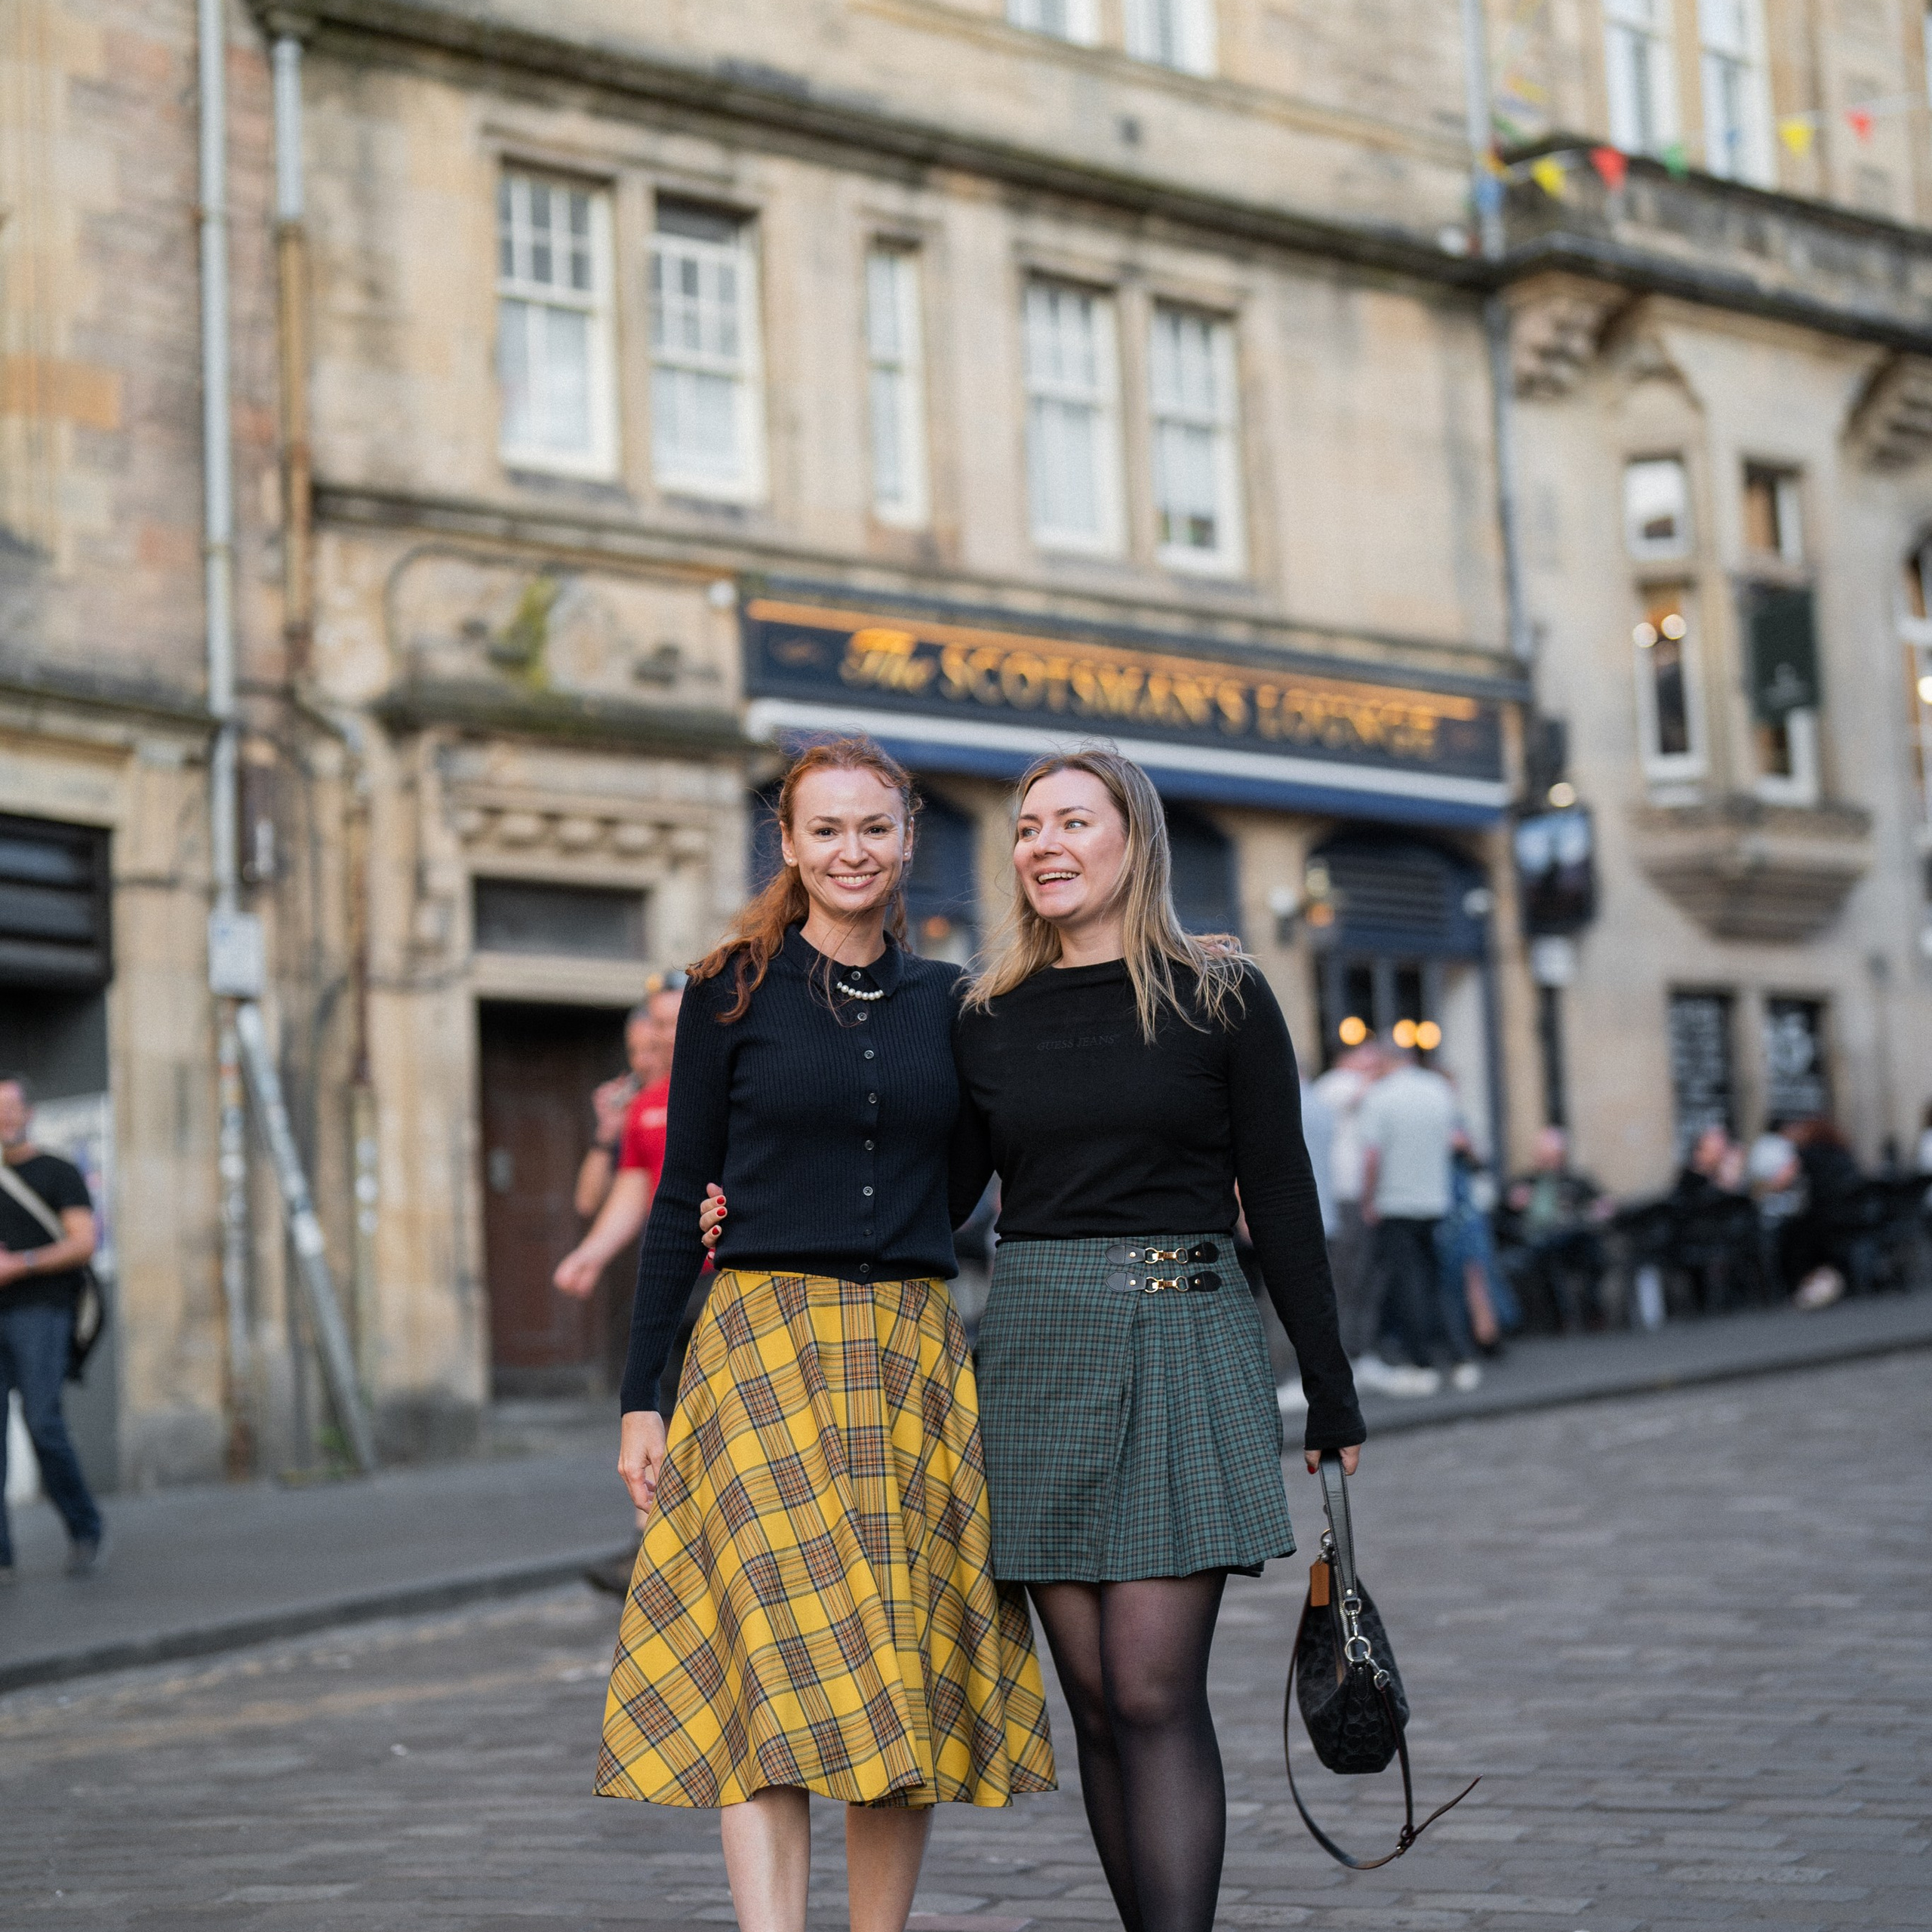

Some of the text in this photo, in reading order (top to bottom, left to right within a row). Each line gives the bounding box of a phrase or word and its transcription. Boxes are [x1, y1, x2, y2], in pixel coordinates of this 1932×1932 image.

[840, 628, 1440, 761] The SCOTSMAN'S LOUNGE
[1036, 1035, 1115, 1051] GUESS JEANS
